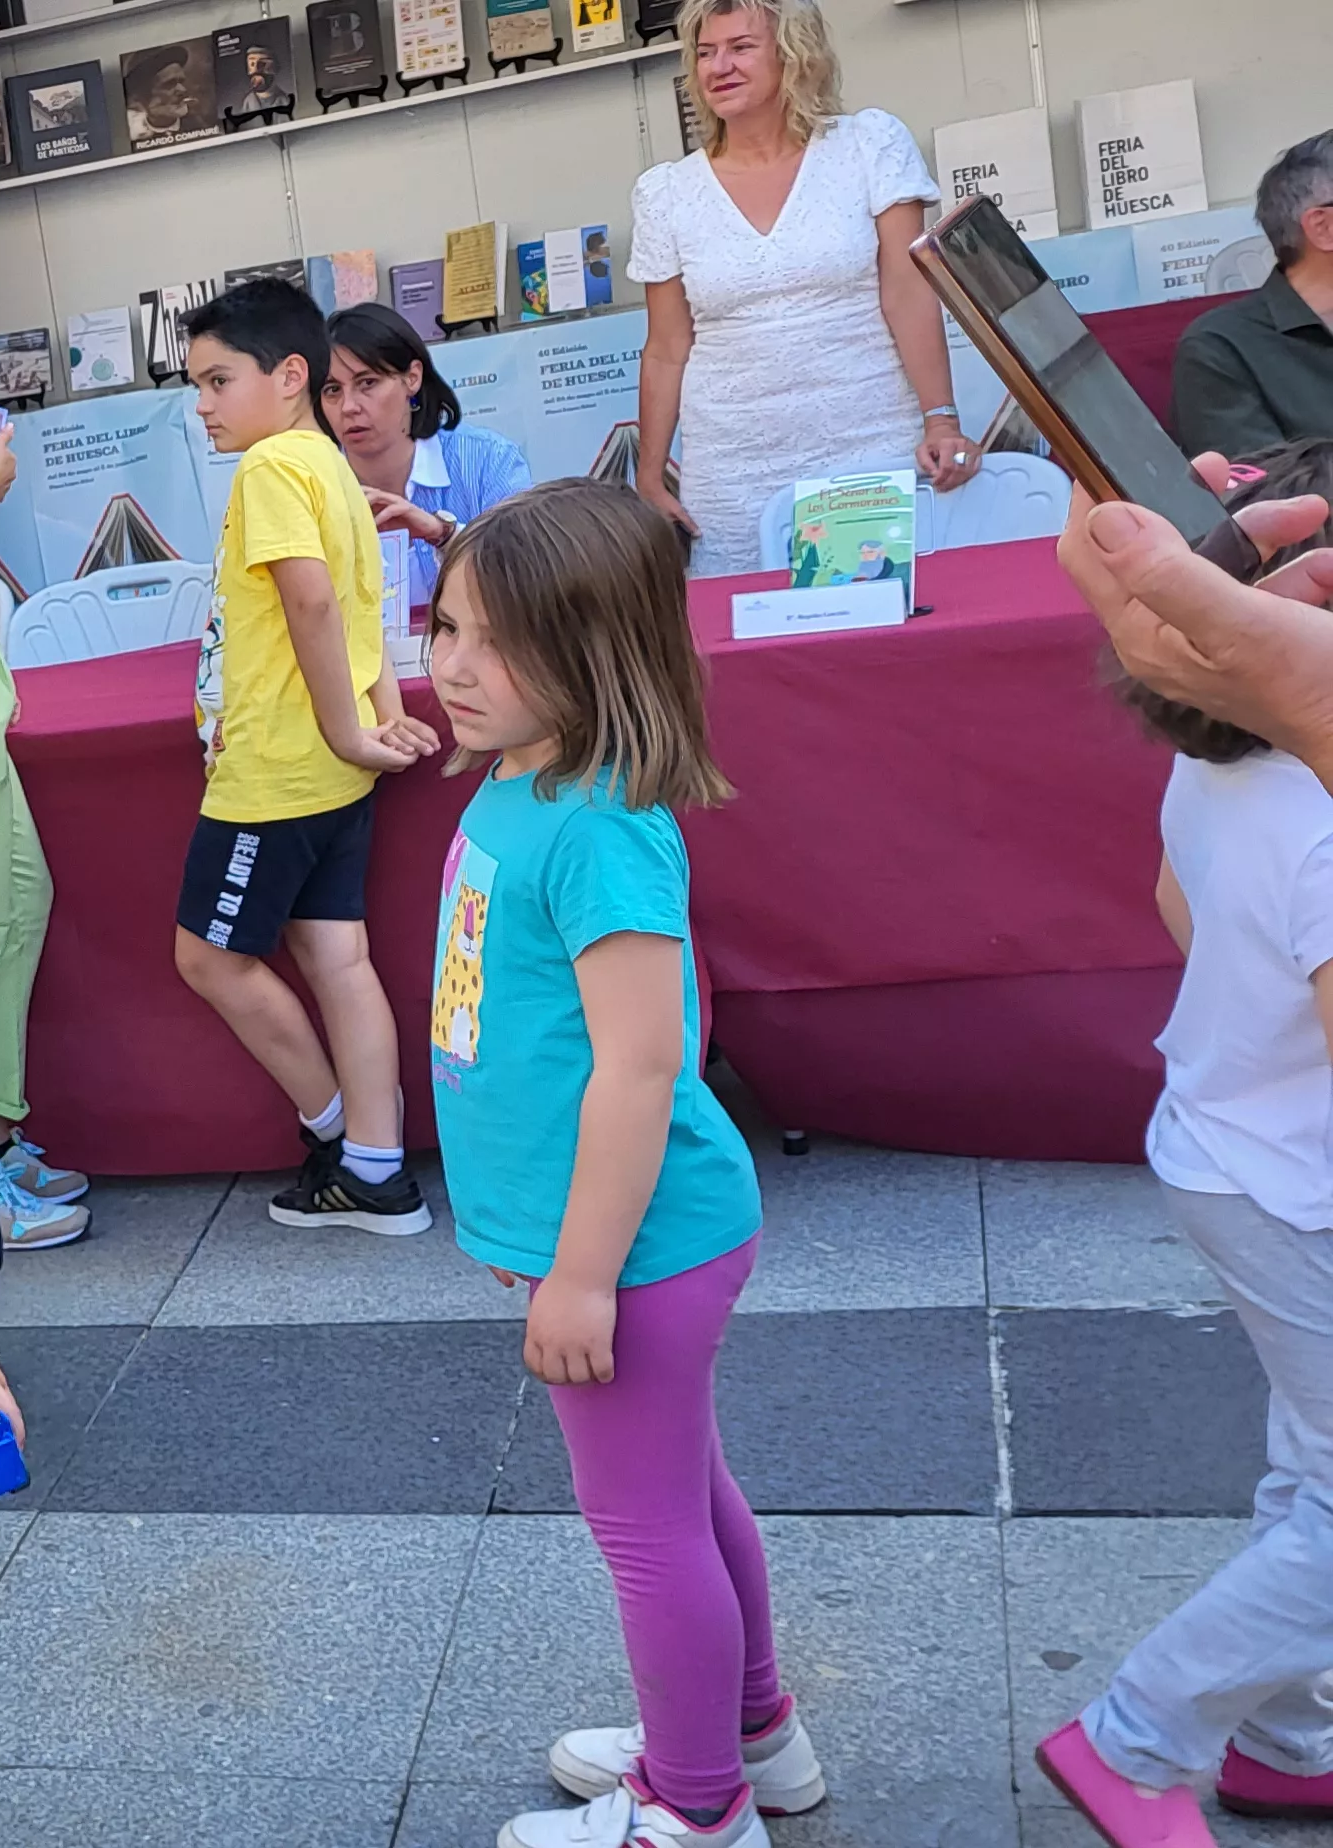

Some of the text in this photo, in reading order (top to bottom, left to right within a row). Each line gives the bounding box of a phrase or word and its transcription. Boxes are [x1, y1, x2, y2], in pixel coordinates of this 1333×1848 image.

[35, 141, 51, 152] LOS
[136, 135, 174, 150] RICARDO
[1098, 136, 1145, 158] FERIA
[37, 150, 48, 160] DE
[1100, 155, 1129, 173] DEL
[952, 162, 1000, 184] FERIA
[1101, 166, 1149, 188] LIBRO
[954, 181, 984, 200] DEL
[1103, 186, 1125, 204] DE
[1104, 193, 1175, 219] HUESCA
[1054, 274, 1090, 290] BRO
[1163, 274, 1188, 290] DE
[539, 359, 587, 376] FERIA
[588, 352, 620, 368] DEL
[452, 373, 499, 390] LIBRO
[541, 367, 627, 391] DE HUESCA
[43, 434, 85, 454] FERIA
[86, 431, 114, 446] DEL
[45, 456, 64, 468] DE
[65, 445, 120, 464] HUESCA
[874, 483, 887, 495] de
[225, 831, 261, 889] READY
[216, 891, 244, 917] TO
